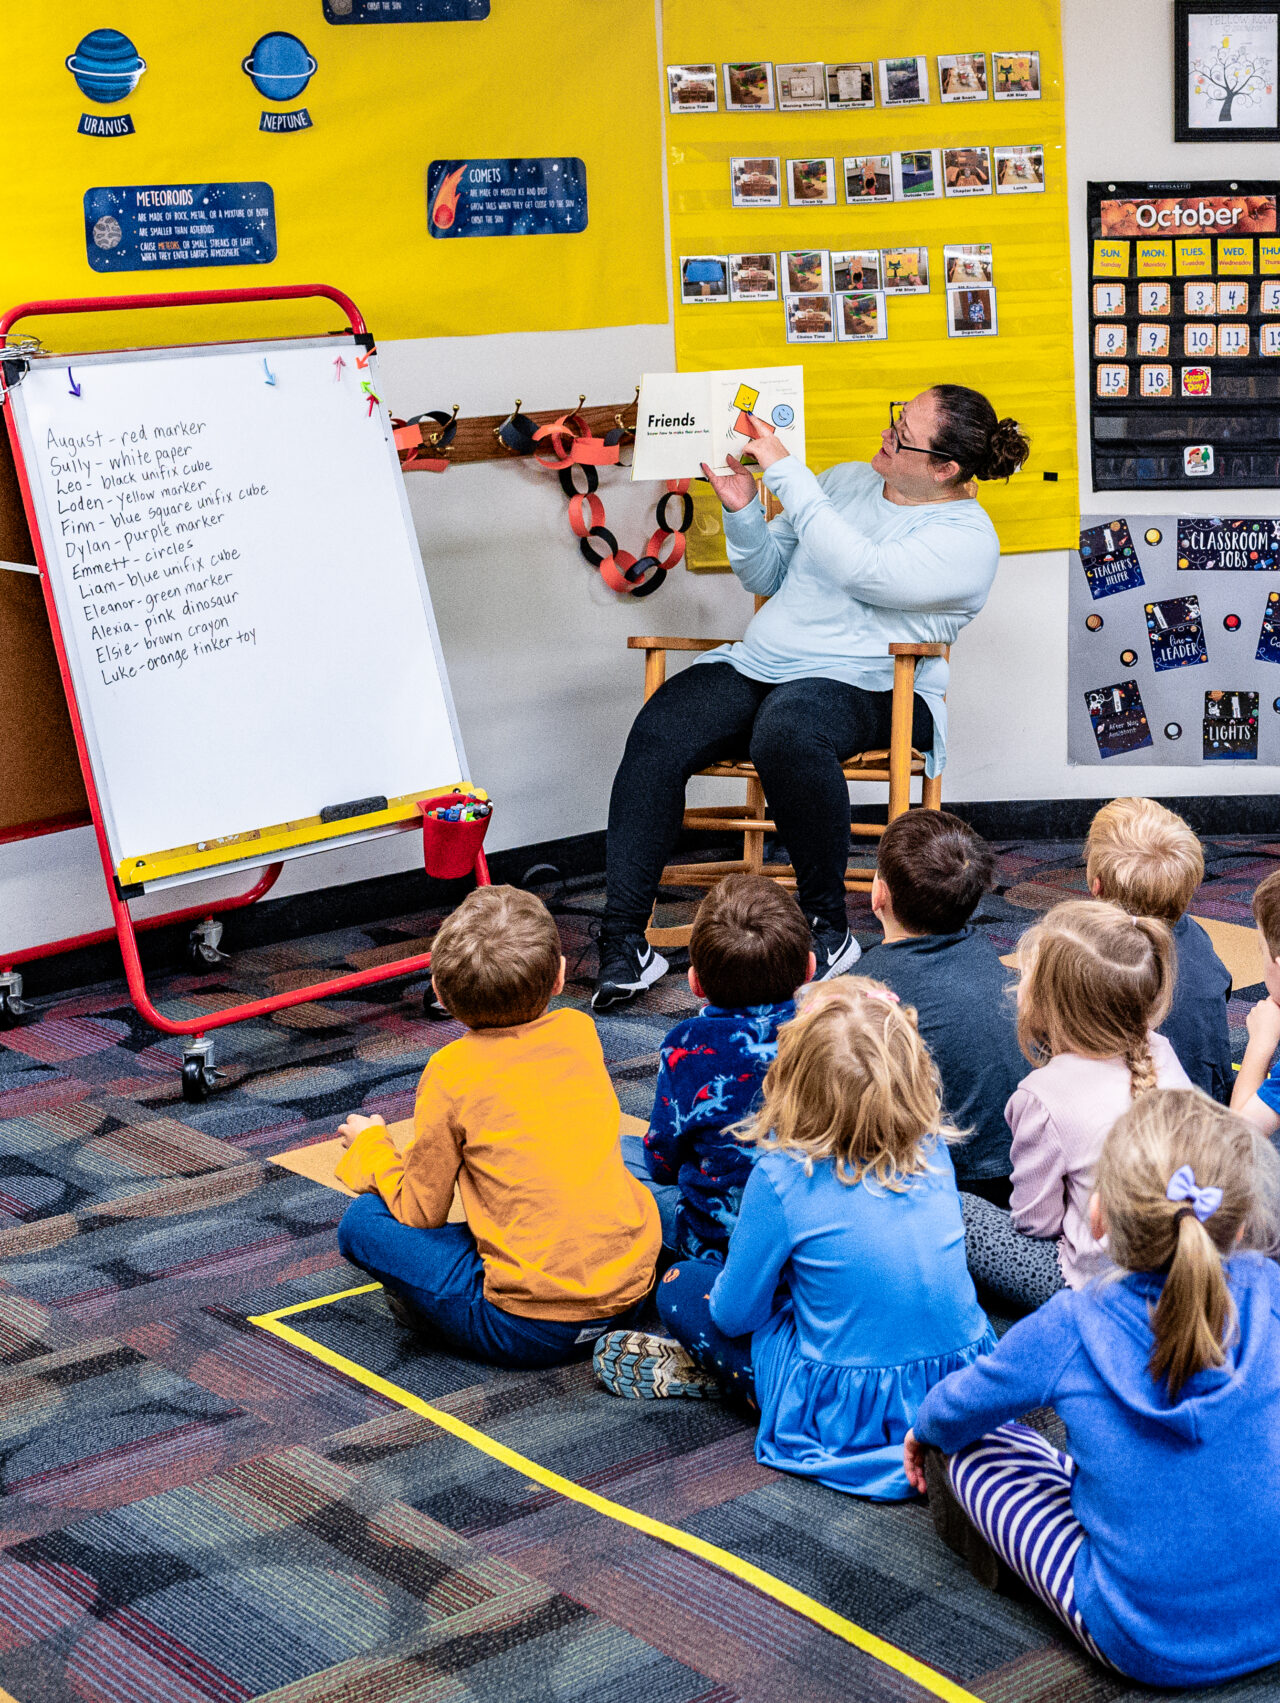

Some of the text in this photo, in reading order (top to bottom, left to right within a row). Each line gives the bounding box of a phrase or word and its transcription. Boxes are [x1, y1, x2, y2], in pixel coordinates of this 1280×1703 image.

[84, 116, 129, 135] URANUS
[263, 112, 308, 130] NEPTUNE
[470, 168, 501, 183] COMETS
[136, 189, 193, 207] METEOROIDS
[479, 189, 491, 197] MADE
[525, 201, 533, 209] GET
[138, 213, 146, 222] ARE
[149, 212, 163, 221] MADE
[165, 211, 171, 220] OF
[209, 210, 217, 219] OR
[219, 210, 223, 218] A
[224, 209, 245, 218] MIXTURE
[247, 209, 253, 217] OF
[256, 208, 269, 217] BOTH
[1136, 202, 1242, 227] October
[139, 225, 215, 237] ARE SMALLER THAN ASTEROIDS
[140, 242, 156, 251] CAUSE
[183, 241, 190, 249] OR
[192, 240, 207, 249] SMALL
[210, 239, 229, 247] STREAKS
[232, 238, 238, 246] OF
[1100, 248, 1122, 258] SUN.
[1142, 249, 1167, 258] MON.
[1181, 248, 1205, 256] TUES.
[1223, 248, 1247, 256] WED.
[141, 252, 157, 261] WHEN
[159, 252, 171, 260] THEY
[173, 251, 188, 260] ENTER
[210, 248, 239, 258] ATMOSPHERE
[1106, 292, 1112, 307] 1
[1150, 292, 1158, 306] 2
[1196, 291, 1204, 305] 3
[1228, 290, 1236, 305] 4
[1272, 290, 1280, 305] 5
[1106, 333, 1115, 347] 8
[1149, 332, 1157, 347] 9
[1192, 332, 1208, 346] 10
[1226, 331, 1241, 346] 11
[1105, 372, 1164, 387] 15 16
[1184, 371, 1206, 383] Special
[1188, 381, 1207, 391] Day!
[648, 412, 695, 427] Friends
[47, 421, 206, 457] August red marker
[50, 445, 192, 478] Sully white paper
[56, 459, 213, 495] Leo black unifix cube
[161, 480, 207, 498] marker
[61, 483, 269, 536] Finn blue square unifix cube
[176, 512, 225, 536] marker
[1191, 531, 1268, 550] CLASSROOM
[72, 556, 130, 580] Emmett
[130, 568, 160, 587] blue
[163, 556, 204, 578] unifix
[211, 547, 241, 566] cube
[1093, 558, 1132, 578] TEACHER'S
[1219, 551, 1248, 568] JOBS
[1105, 571, 1129, 585] HELPER
[145, 588, 181, 613] green
[185, 572, 233, 594] marker
[145, 608, 175, 636] pink
[182, 591, 239, 616] dinosaur
[144, 631, 182, 650] brown
[188, 615, 230, 639] crayon
[1170, 635, 1185, 646] line
[193, 636, 233, 656] tinker
[236, 627, 257, 645] toy
[1161, 644, 1198, 661] LEADER
[1210, 725, 1250, 741] LIGHTS
